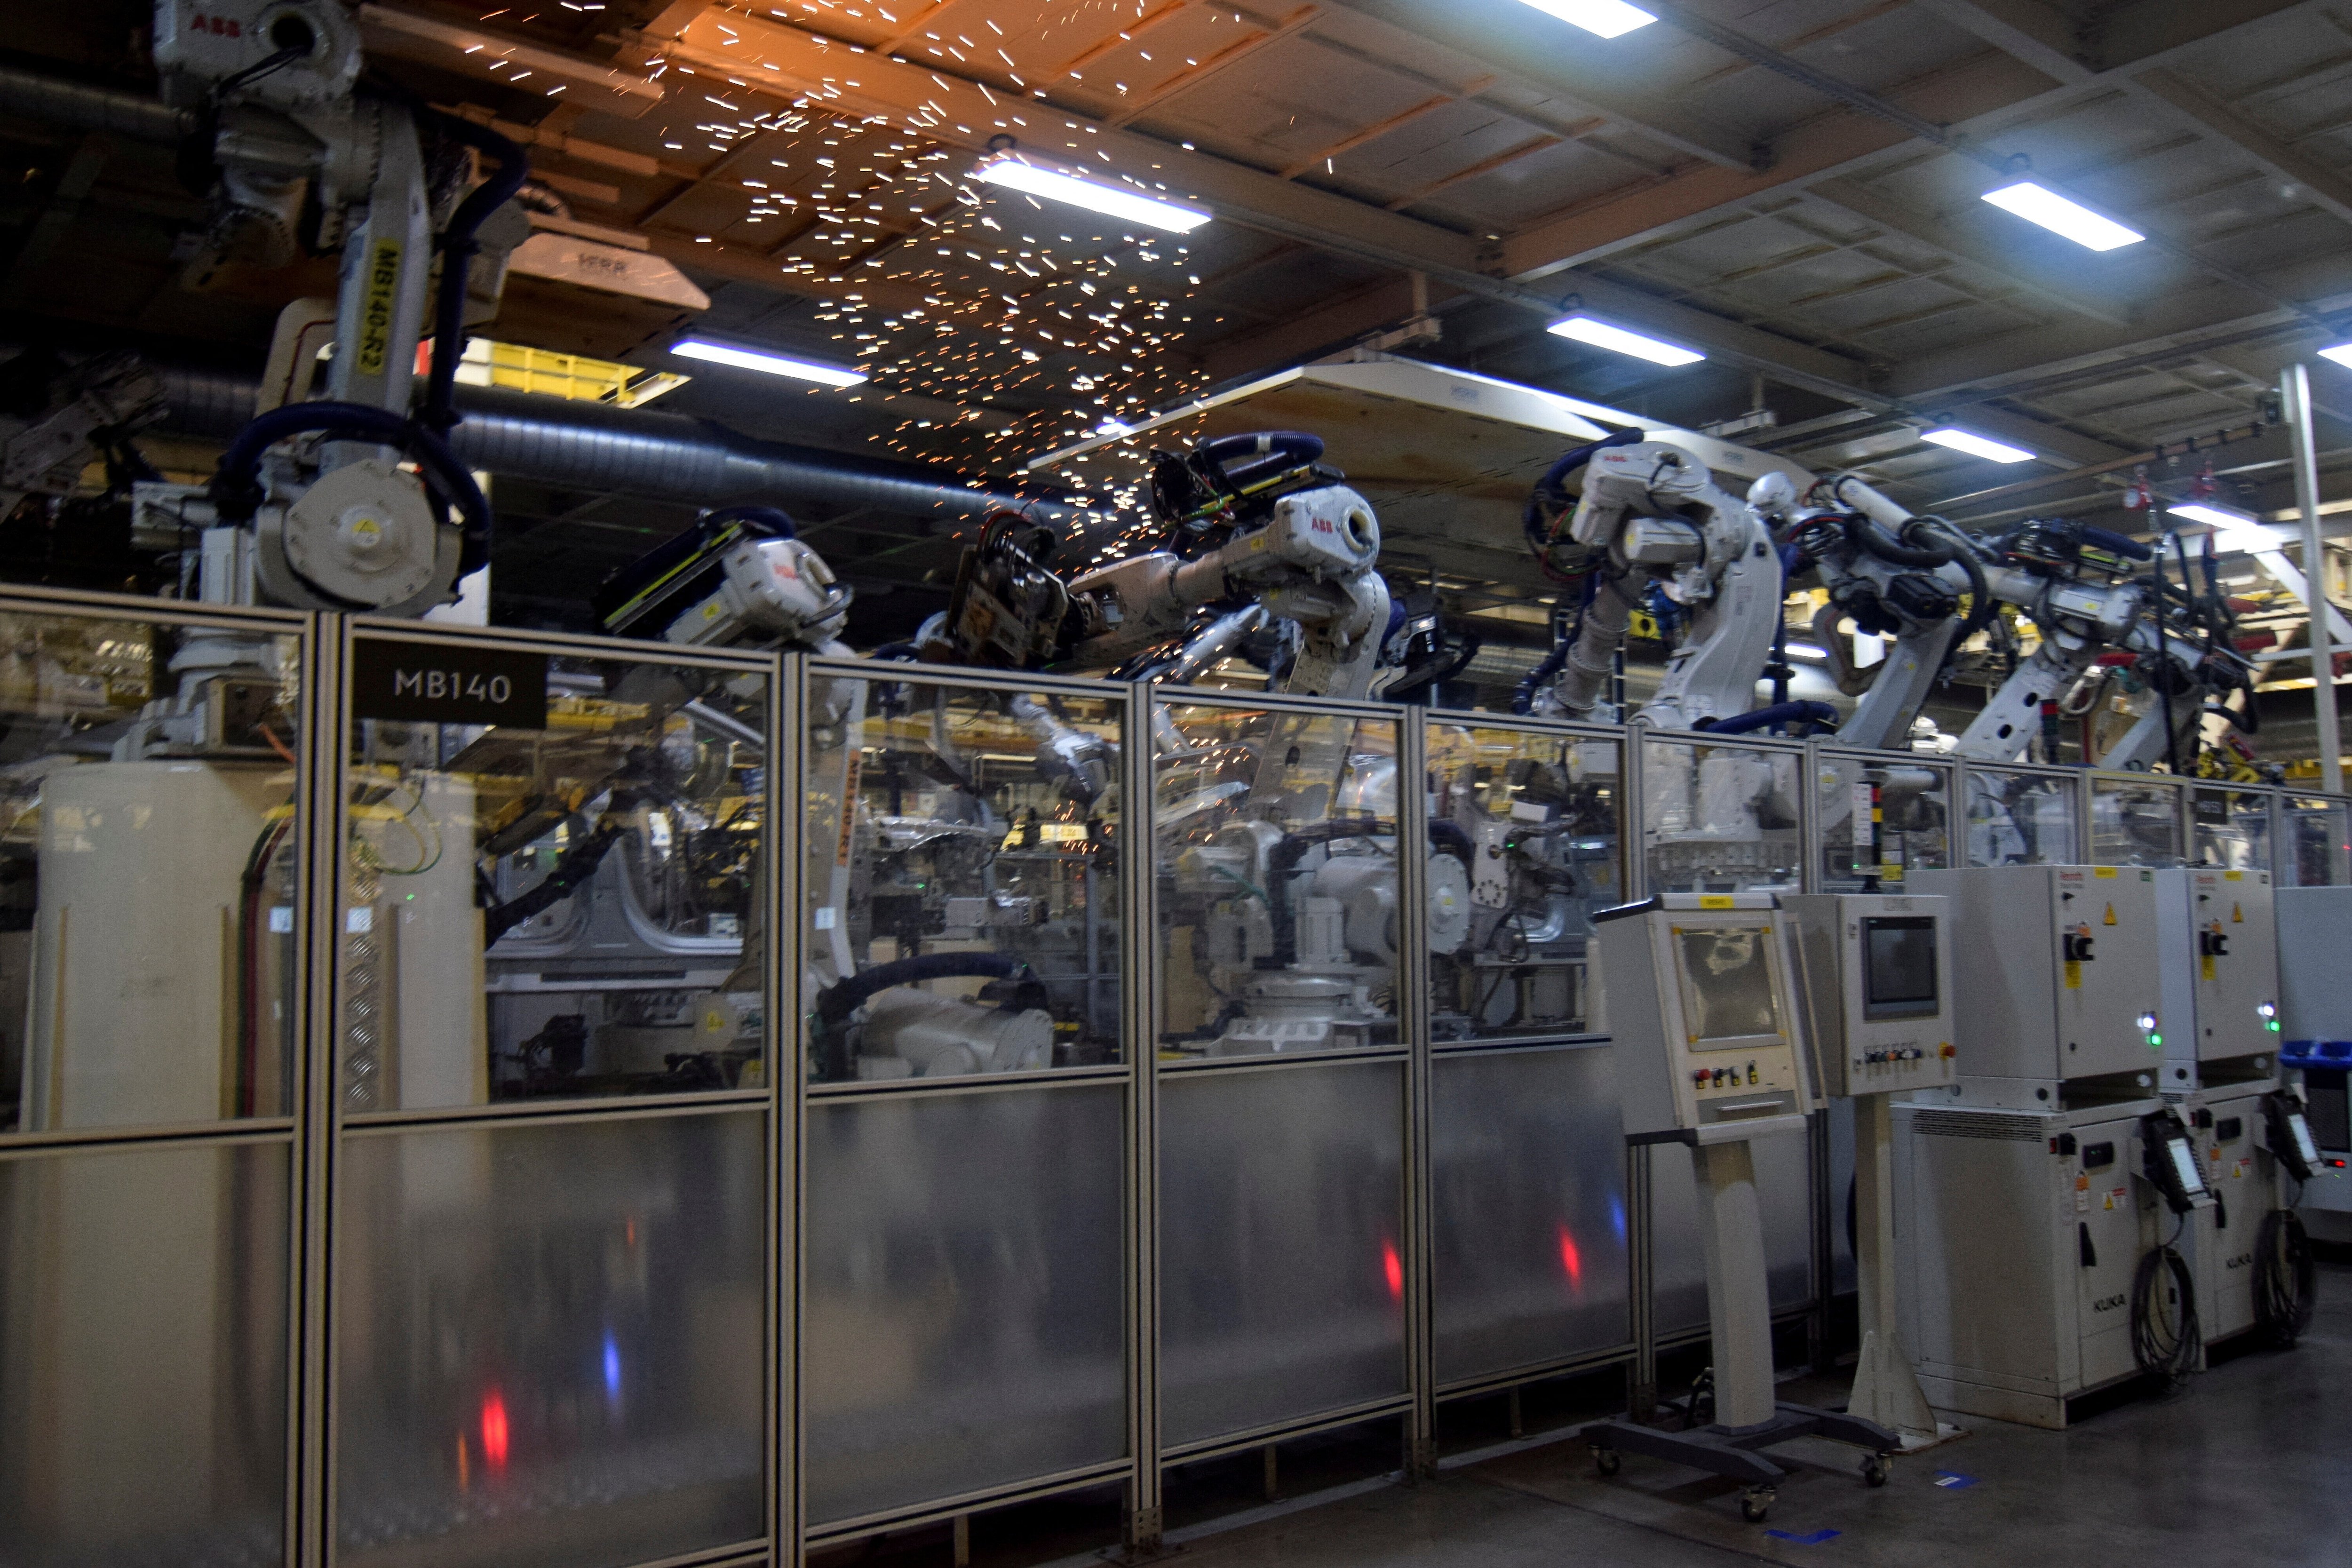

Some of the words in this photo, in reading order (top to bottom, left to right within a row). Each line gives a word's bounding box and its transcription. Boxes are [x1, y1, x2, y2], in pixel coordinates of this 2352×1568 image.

[190, 13, 241, 38] ABB
[361, 248, 397, 367] MB140-R2
[1311, 517, 1333, 534] ABB
[394, 669, 512, 703] MB140
[2094, 1294, 2126, 1313] KUKA
